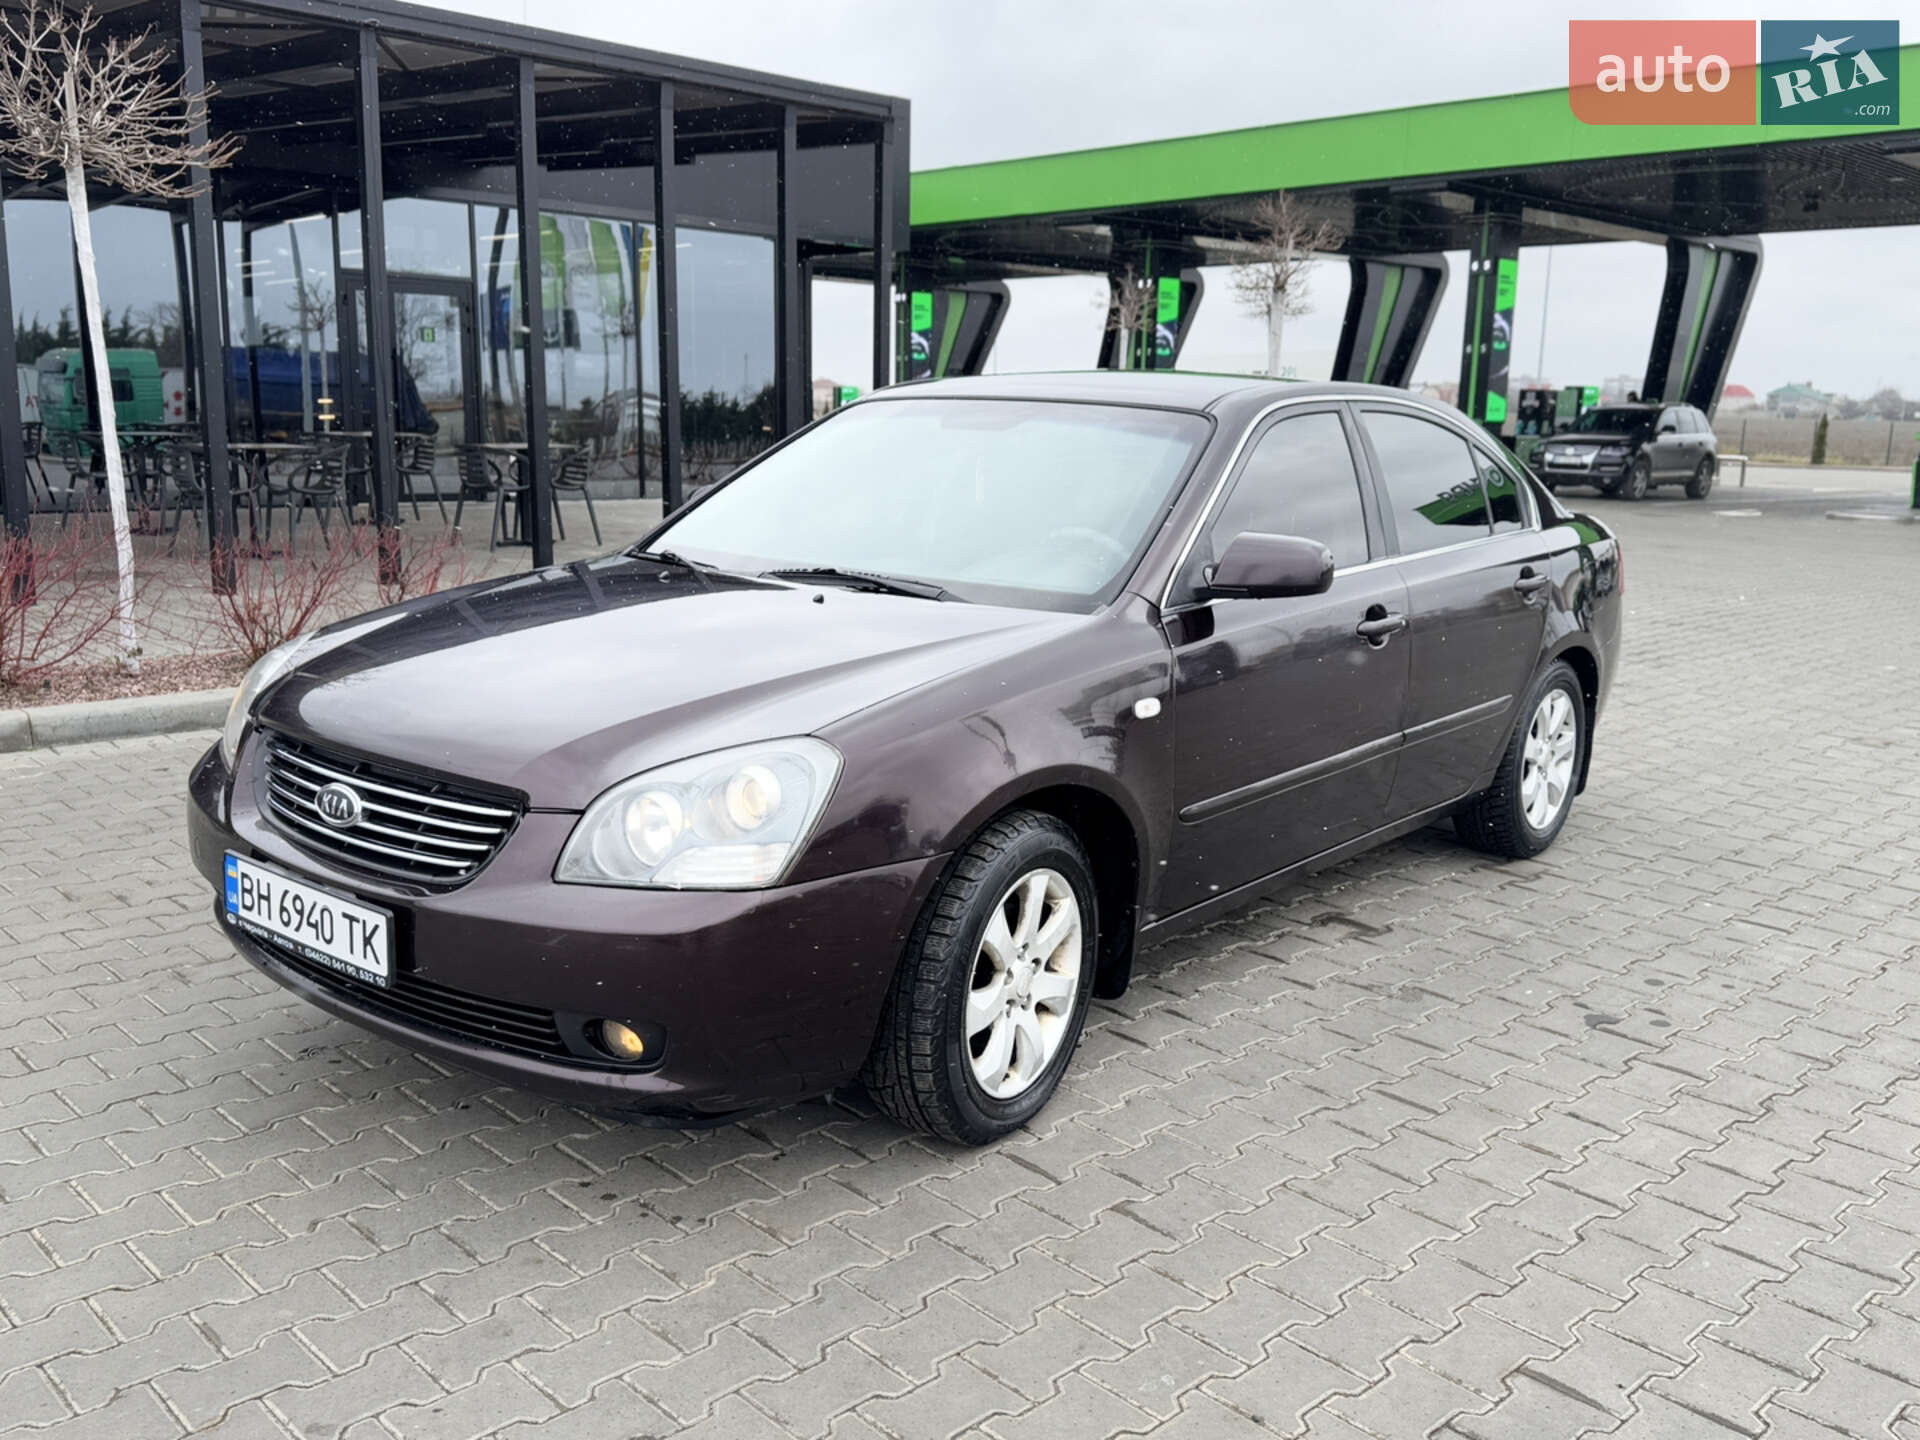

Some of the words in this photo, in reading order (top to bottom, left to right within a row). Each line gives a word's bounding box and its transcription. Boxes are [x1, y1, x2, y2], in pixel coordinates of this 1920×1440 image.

[320, 792, 348, 819] KIA
[241, 872, 272, 921] BH
[279, 889, 334, 945] 6940
[341, 911, 380, 966] TK
